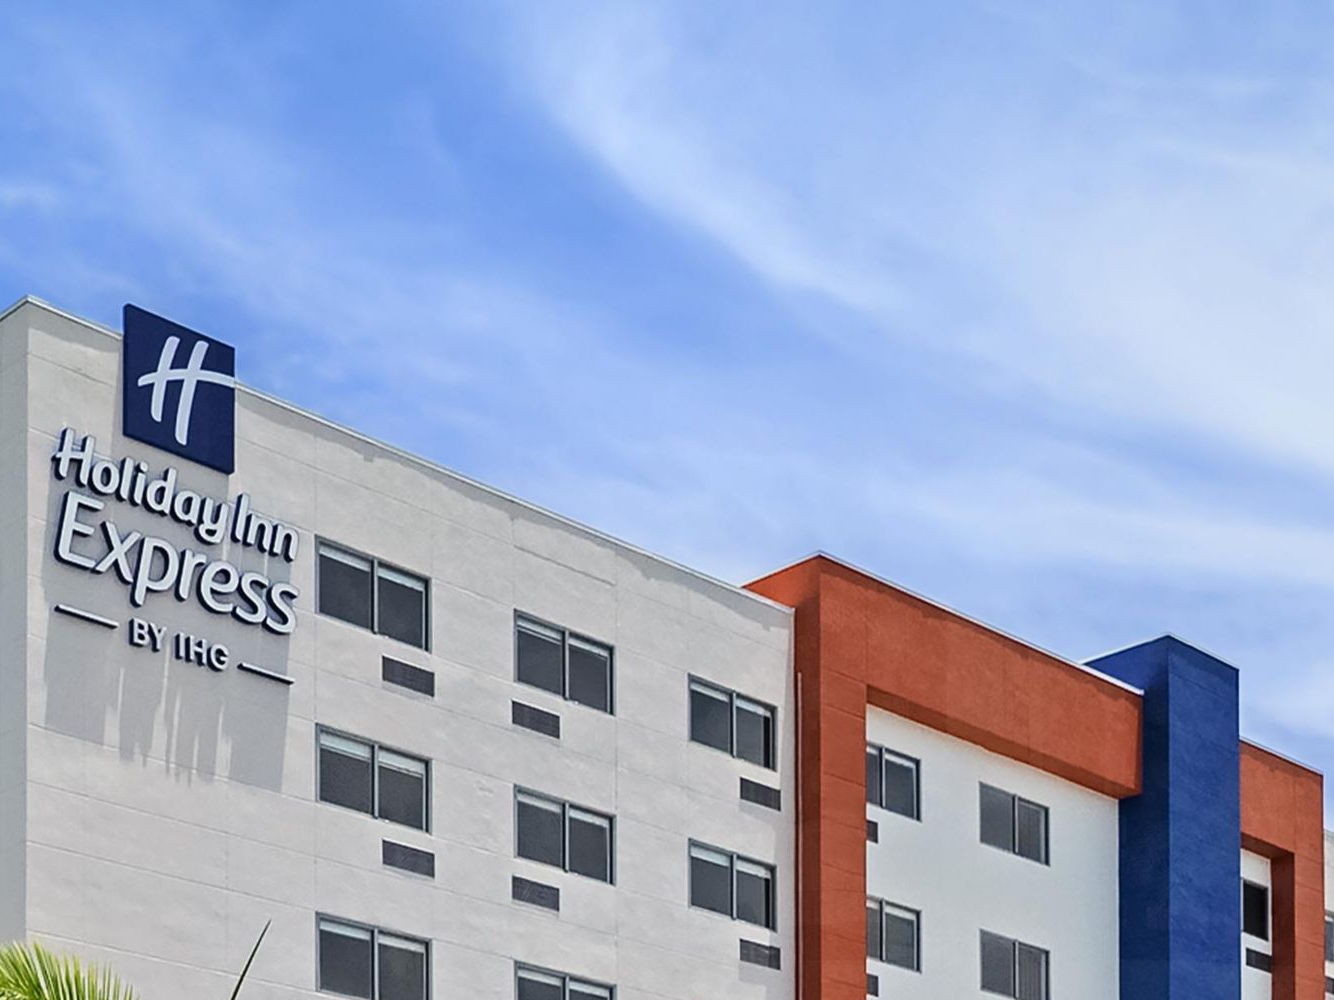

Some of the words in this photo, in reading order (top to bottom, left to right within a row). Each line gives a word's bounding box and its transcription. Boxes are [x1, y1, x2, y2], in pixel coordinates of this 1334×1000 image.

[52, 427, 229, 545] Holiday
[230, 492, 300, 562] Inn
[54, 490, 300, 635] Express
[129, 618, 168, 652] BY
[174, 632, 230, 672] IHG
